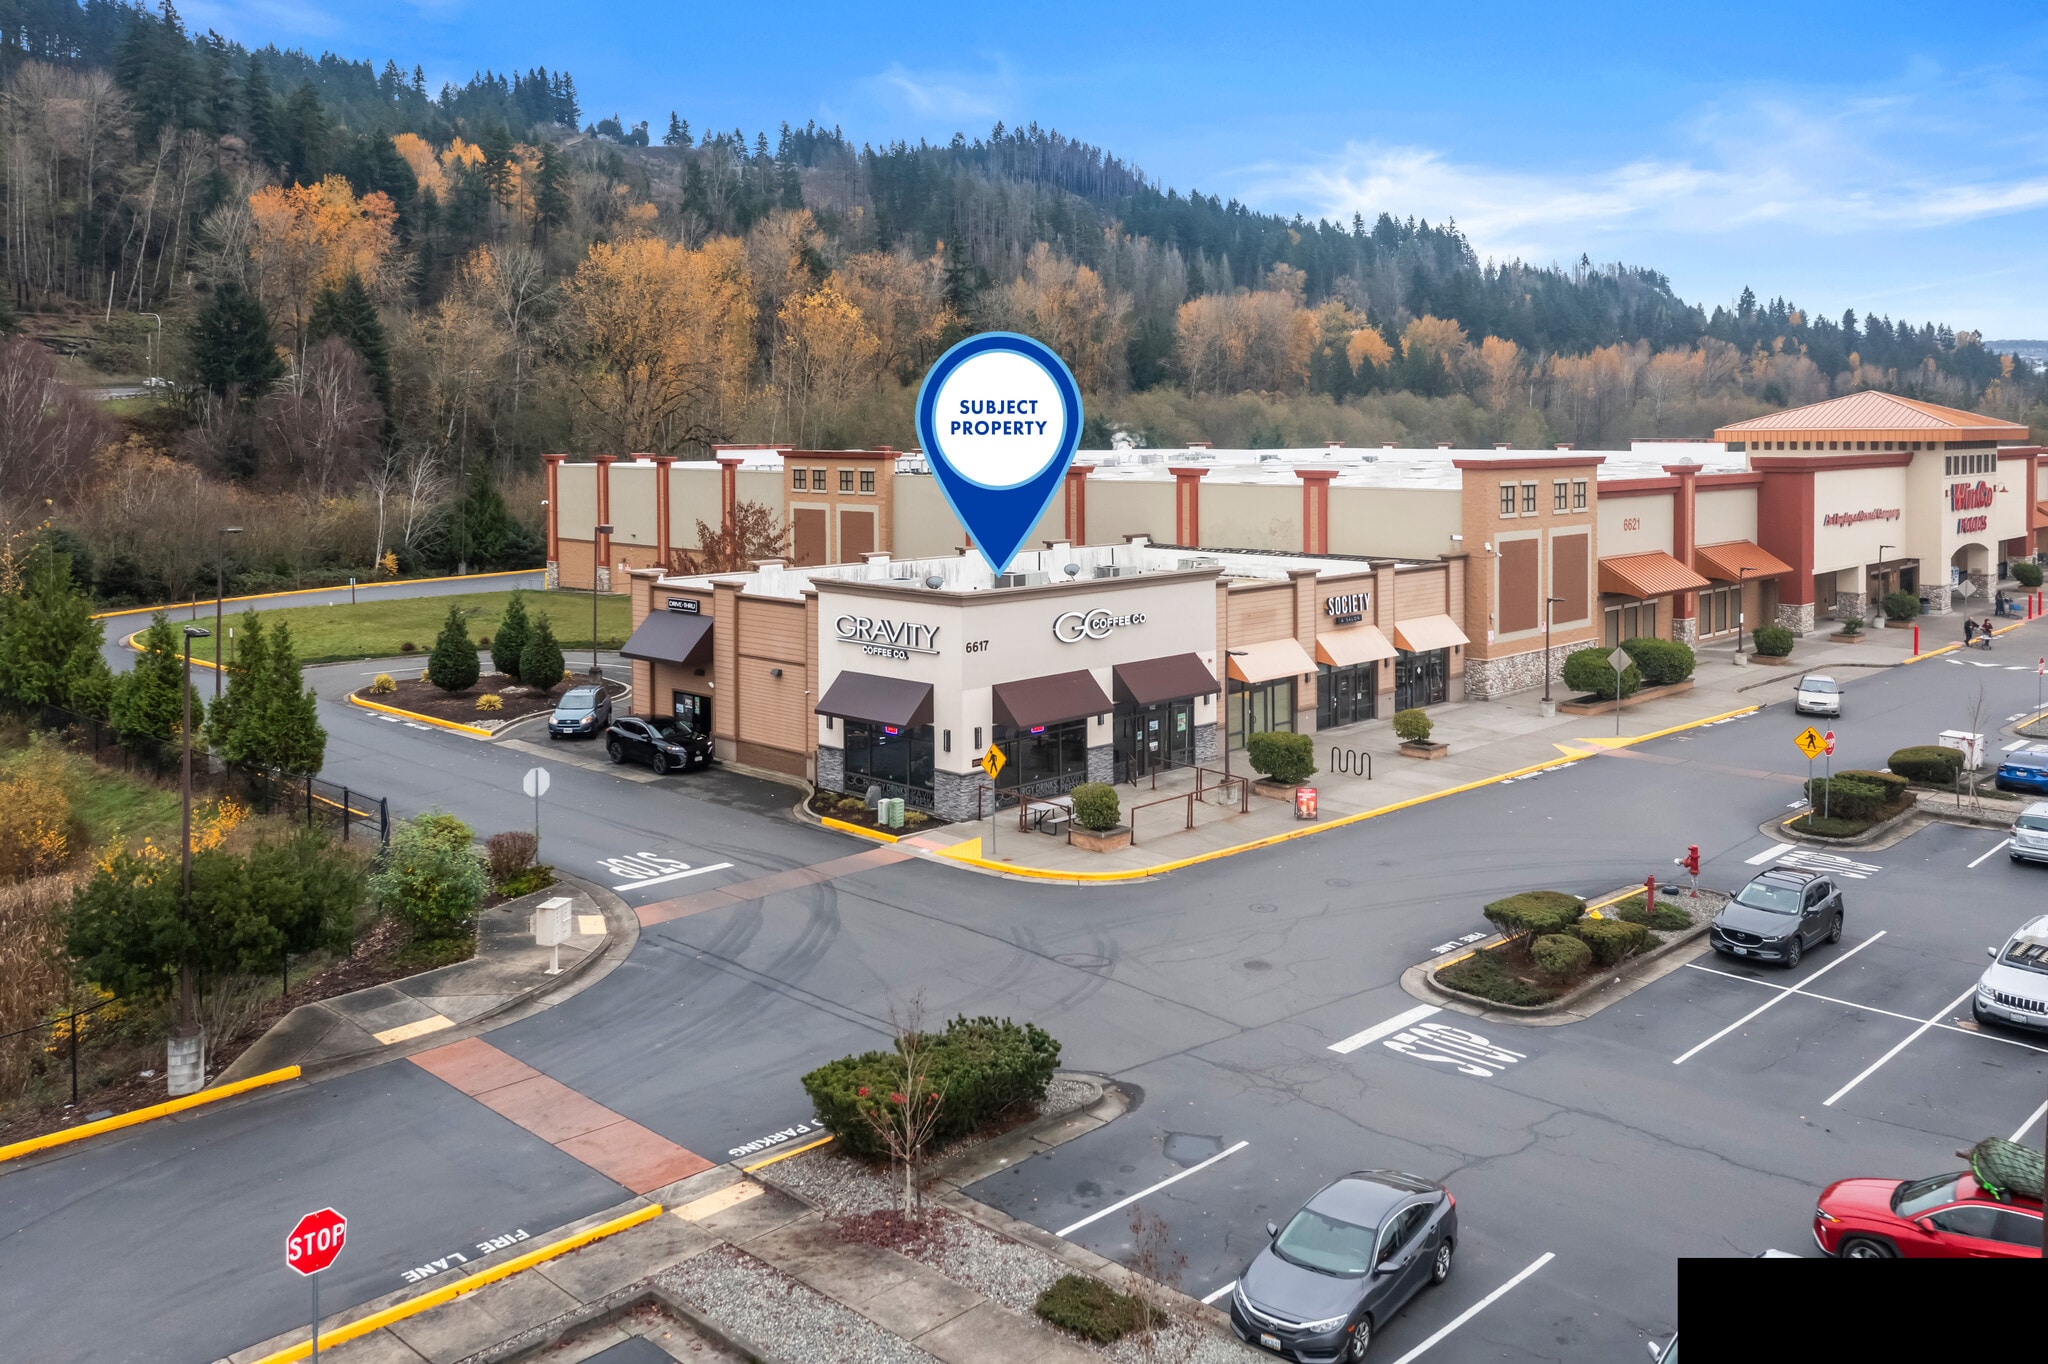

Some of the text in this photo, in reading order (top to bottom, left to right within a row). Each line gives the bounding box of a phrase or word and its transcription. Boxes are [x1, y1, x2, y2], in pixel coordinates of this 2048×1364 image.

[1623, 517, 1641, 531] 6621
[1327, 593, 1370, 616] SOCIETY
[834, 614, 940, 649] GRAVITY
[1091, 616, 1131, 630] COFFEE
[1132, 613, 1147, 624] CO
[862, 645, 909, 660] COFFEE CO.
[965, 640, 989, 653] 6617
[596, 852, 691, 879] STOP
[1383, 1023, 1527, 1077] STOP
[728, 1123, 811, 1157] PARKING
[289, 1222, 345, 1261] STOP
[401, 1228, 530, 1283] FIRE LANE
